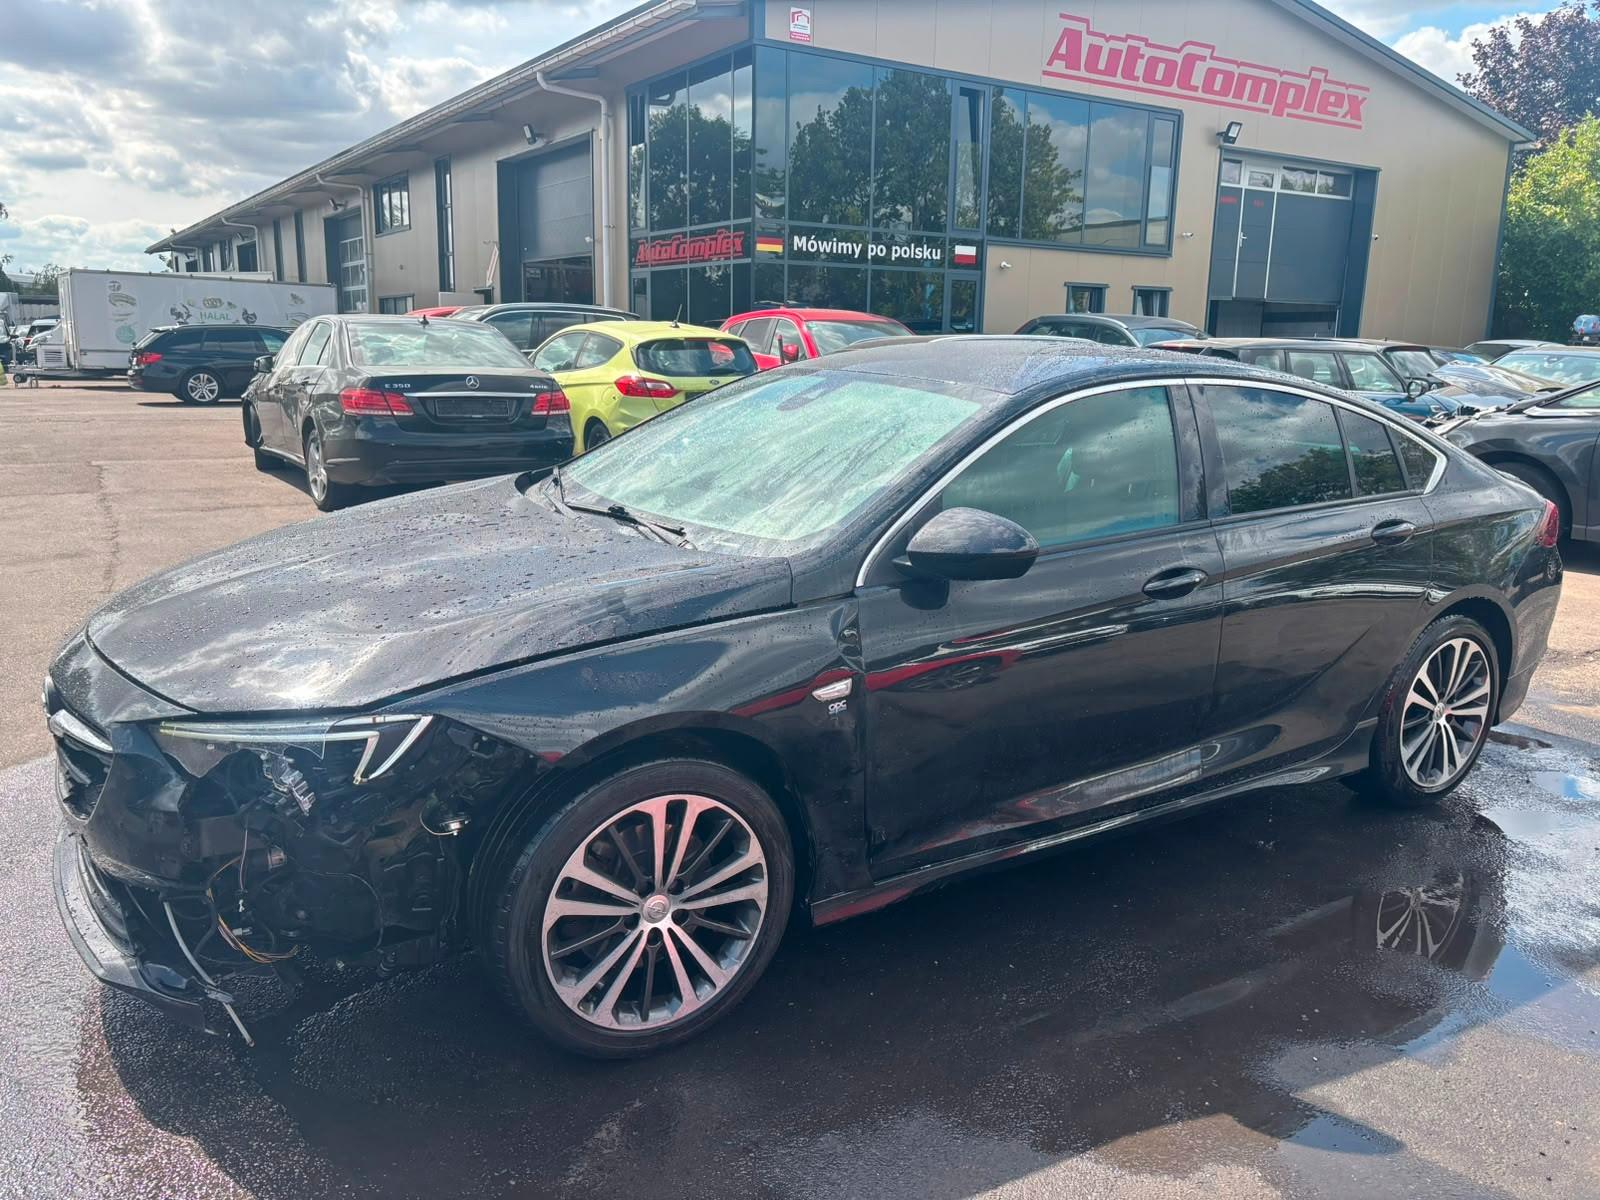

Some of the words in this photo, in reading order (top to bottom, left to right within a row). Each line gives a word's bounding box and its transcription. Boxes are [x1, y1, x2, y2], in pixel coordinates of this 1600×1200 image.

[1046, 27, 1368, 122] AutoComplex
[635, 233, 744, 262] AutoComplex
[793, 235, 862, 259] Mówimy
[867, 243, 887, 260] po
[891, 243, 941, 261] polsku
[200, 311, 231, 321] HALAL
